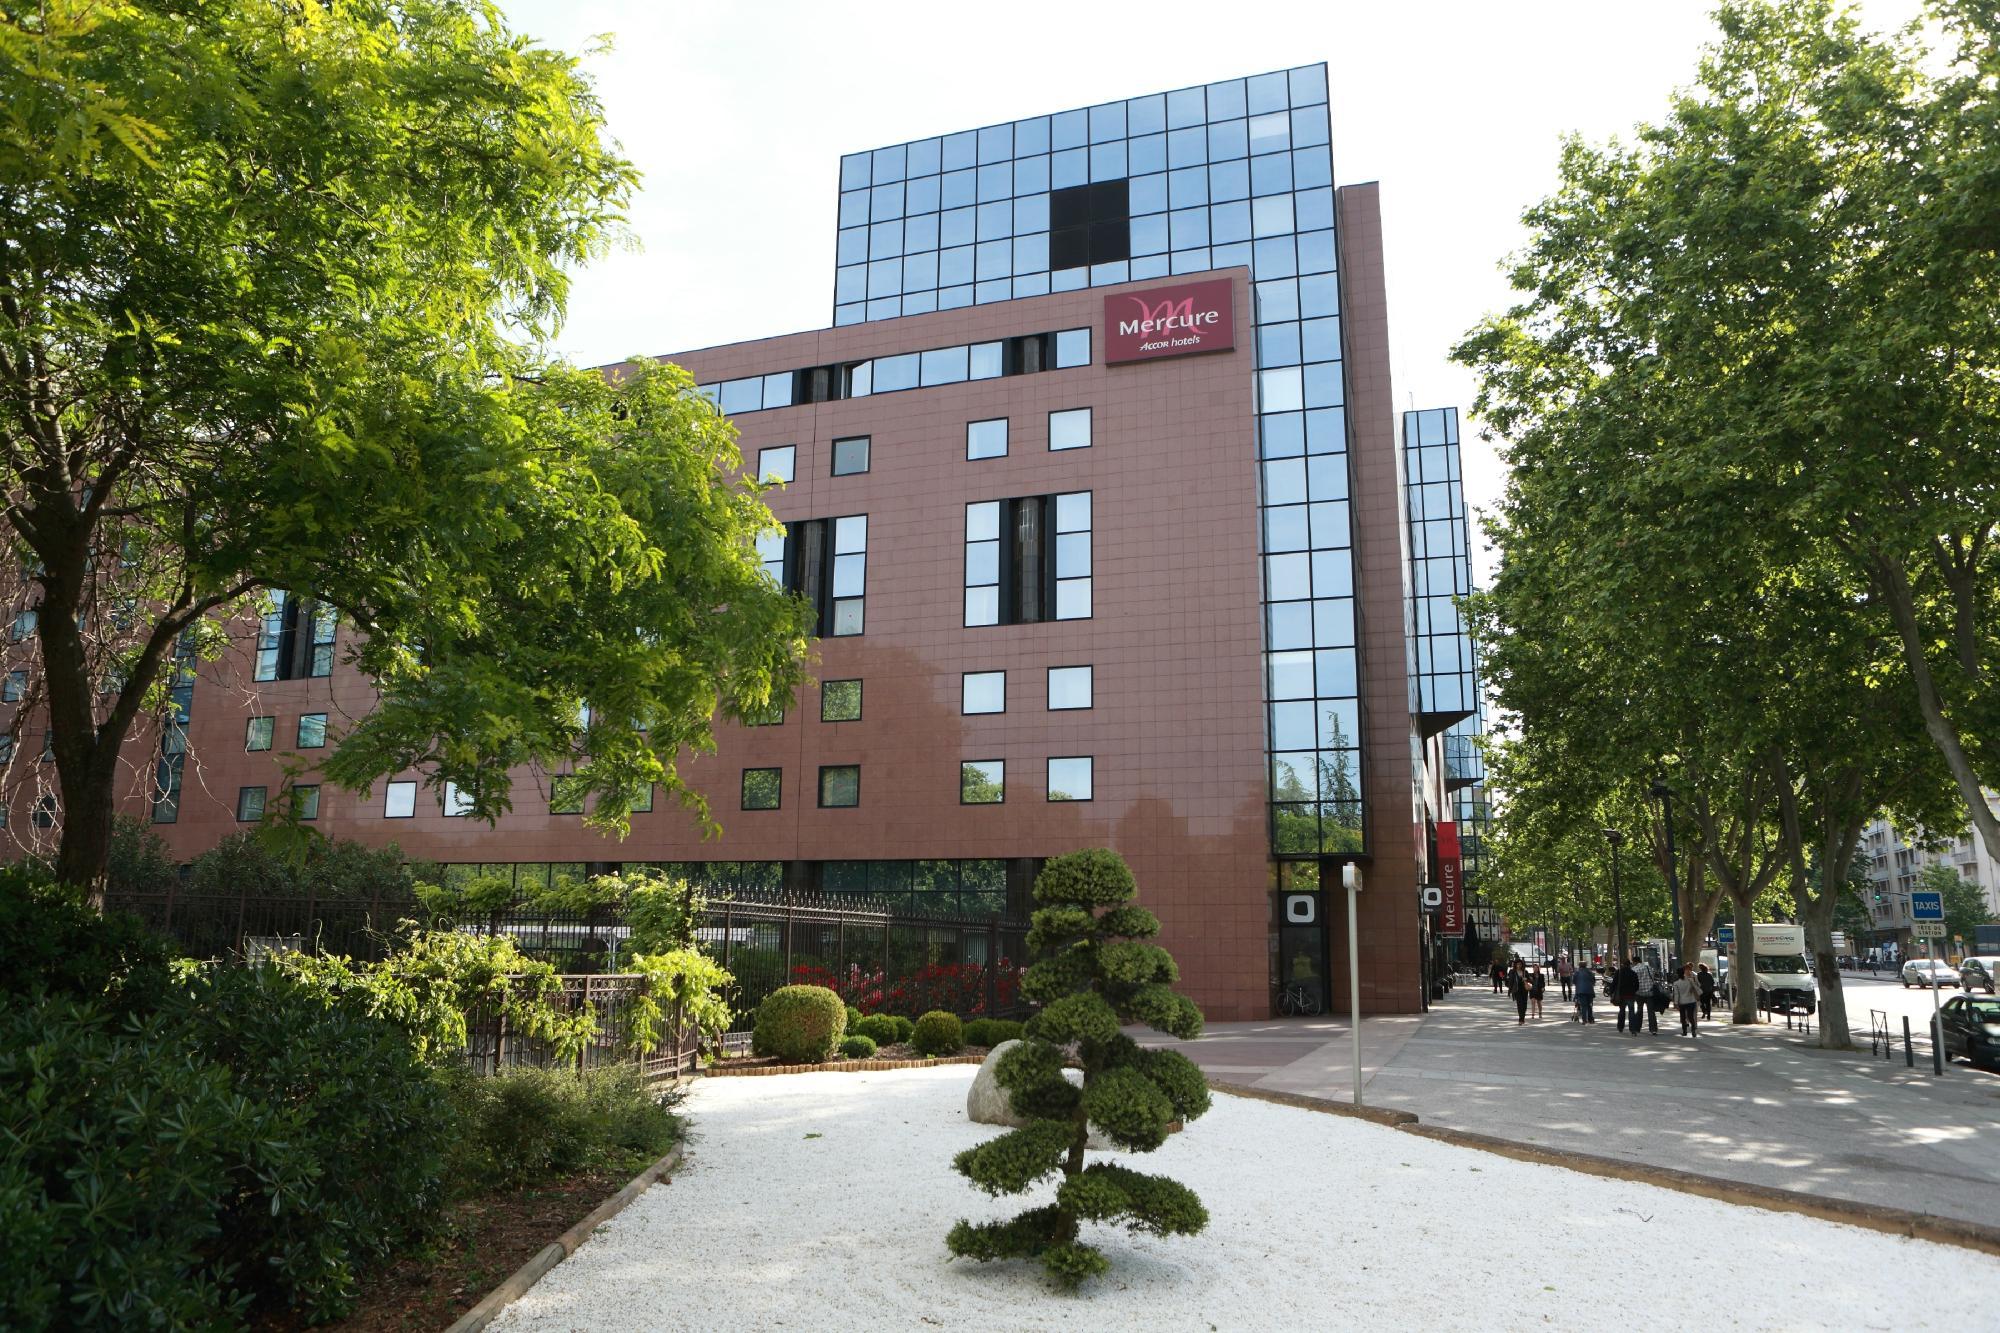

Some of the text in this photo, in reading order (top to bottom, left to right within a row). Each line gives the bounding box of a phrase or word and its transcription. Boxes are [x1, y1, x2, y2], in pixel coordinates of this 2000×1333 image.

[1119, 310, 1219, 336] Mercure
[1171, 334, 1201, 347] hotels
[1444, 864, 1456, 927] Mercure
[1914, 901, 1940, 911] TAXIS
